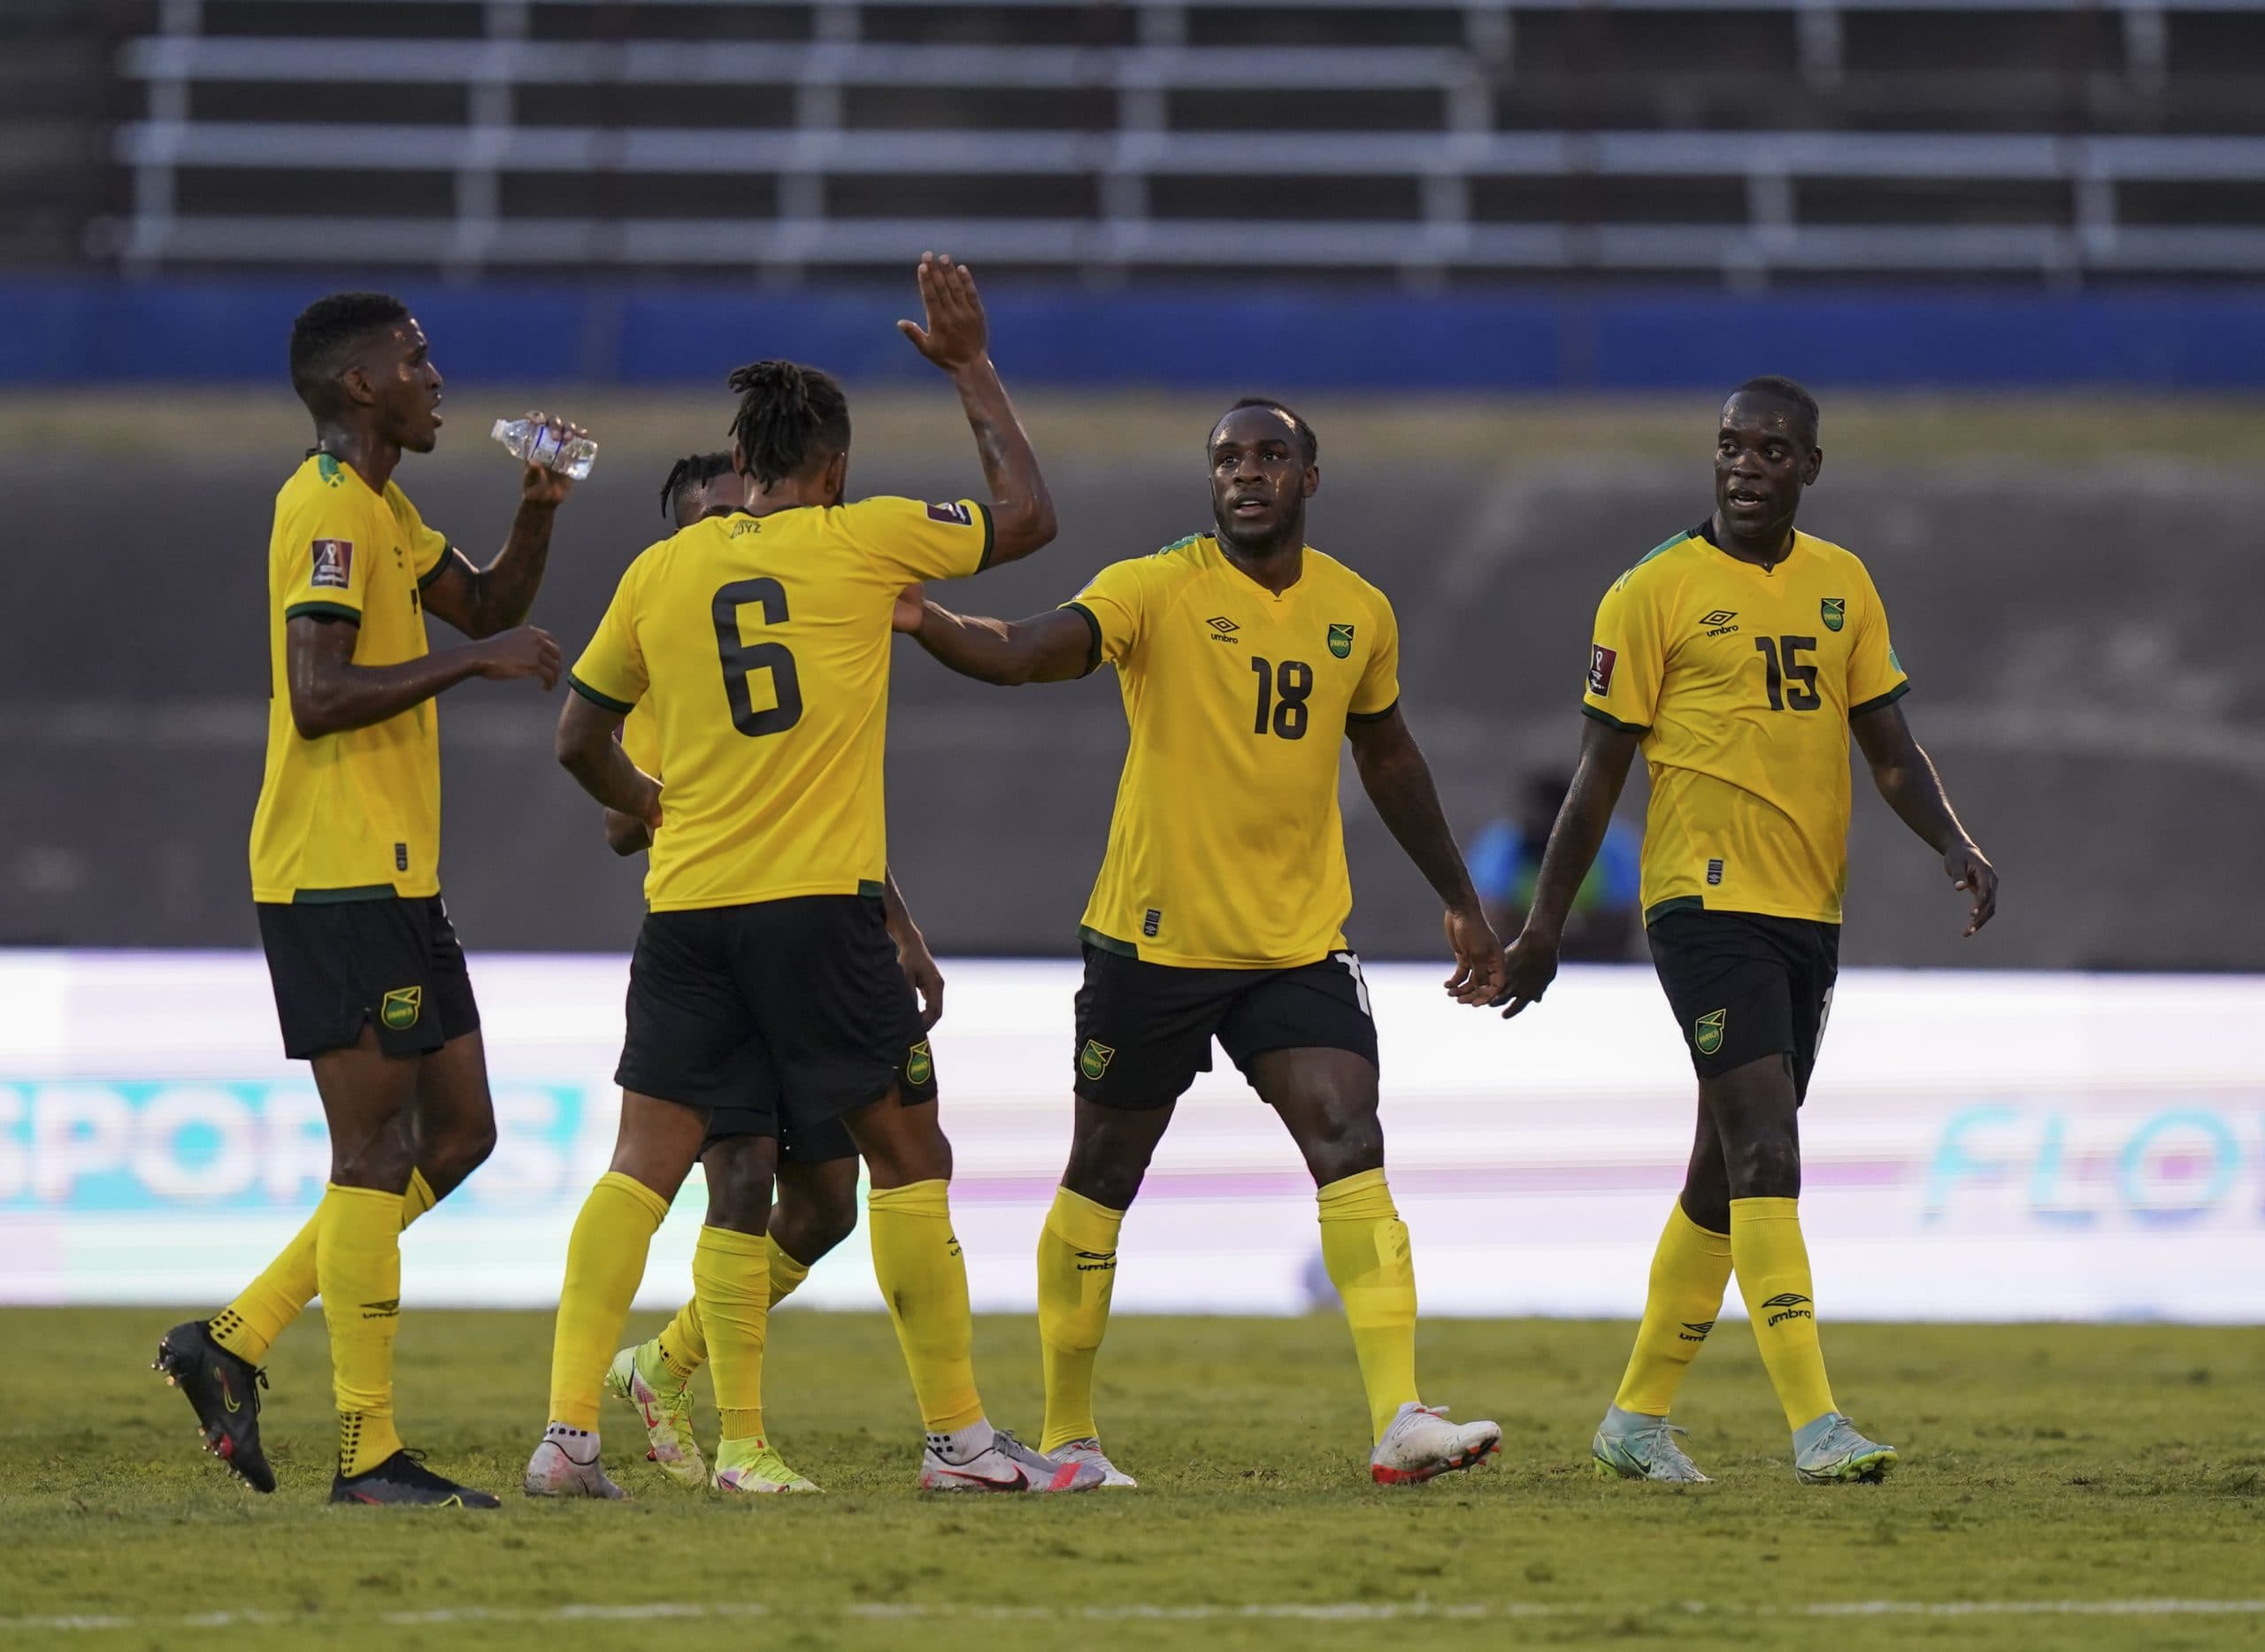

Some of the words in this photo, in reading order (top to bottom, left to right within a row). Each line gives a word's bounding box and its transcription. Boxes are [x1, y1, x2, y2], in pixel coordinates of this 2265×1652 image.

[711, 576, 803, 738] 6
[1210, 633, 1239, 645] umbro
[1706, 624, 1739, 638] umbro
[1251, 656, 1313, 741] 18
[1754, 634, 1822, 711] 15
[1920, 1103, 2265, 1228] FLO
[1767, 1308, 1812, 1327] umbro
